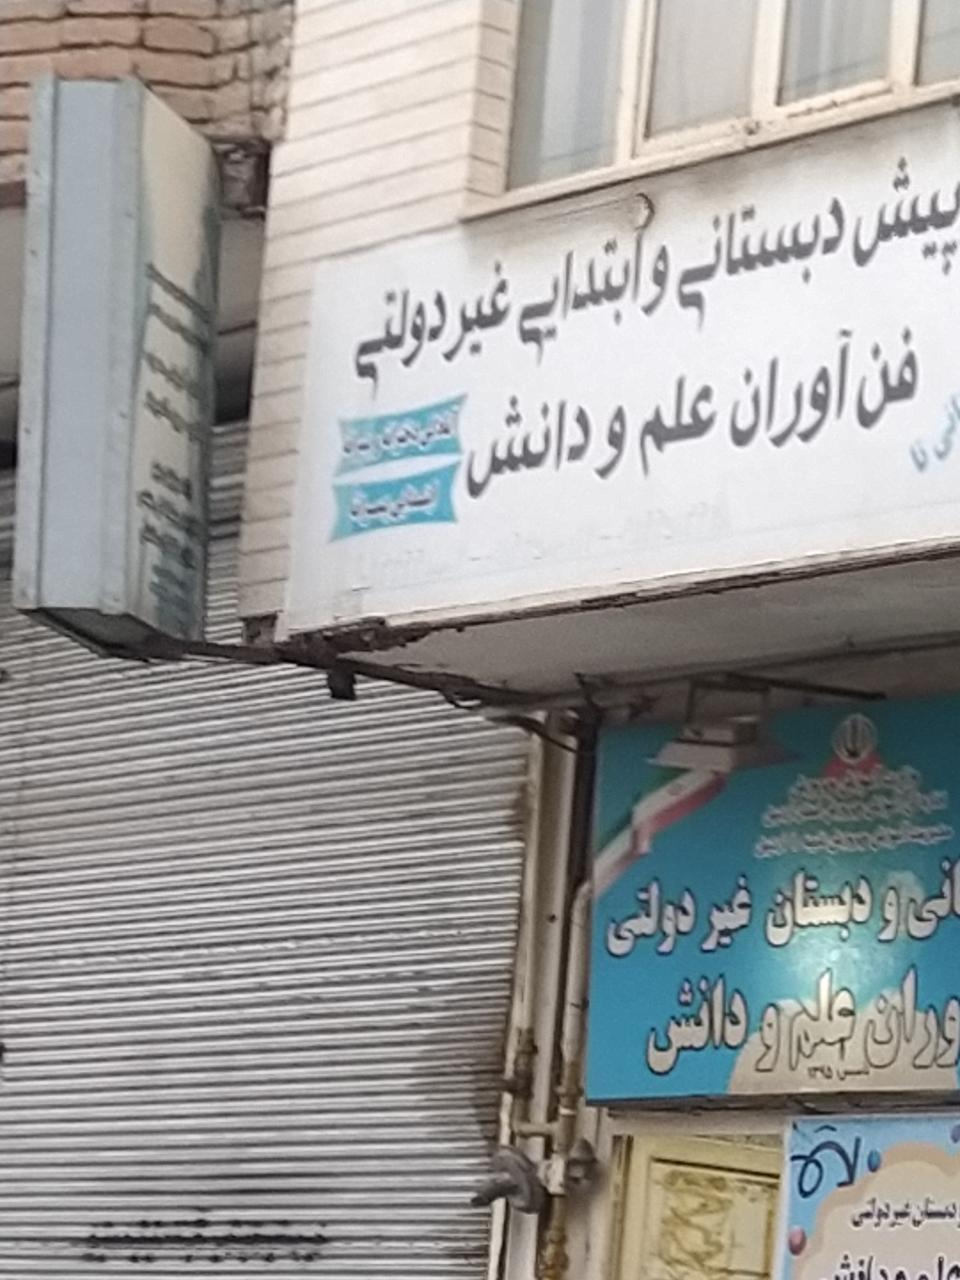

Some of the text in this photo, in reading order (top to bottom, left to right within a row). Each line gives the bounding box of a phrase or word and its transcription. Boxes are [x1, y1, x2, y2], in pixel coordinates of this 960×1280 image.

[442, 260, 513, 362] غیر
[519, 230, 641, 366] ابتدایی
[639, 244, 670, 317] و
[677, 197, 846, 332] دبستانی
[355, 289, 448, 402] دولتی
[729, 329, 852, 448] آوران
[856, 327, 919, 429] فن
[465, 395, 591, 499] دانش
[595, 404, 628, 480] و
[640, 374, 718, 478] علم
[606, 876, 697, 959] دولتی
[699, 872, 752, 953] غیر
[765, 866, 873, 948] دبستان
[876, 885, 900, 944] و
[646, 972, 748, 1077] دانش
[754, 1002, 780, 1073] و
[789, 967, 857, 1073] علم
[851, 1197, 890, 1229] دولتی
[911, 1196, 957, 1229] دبستان
